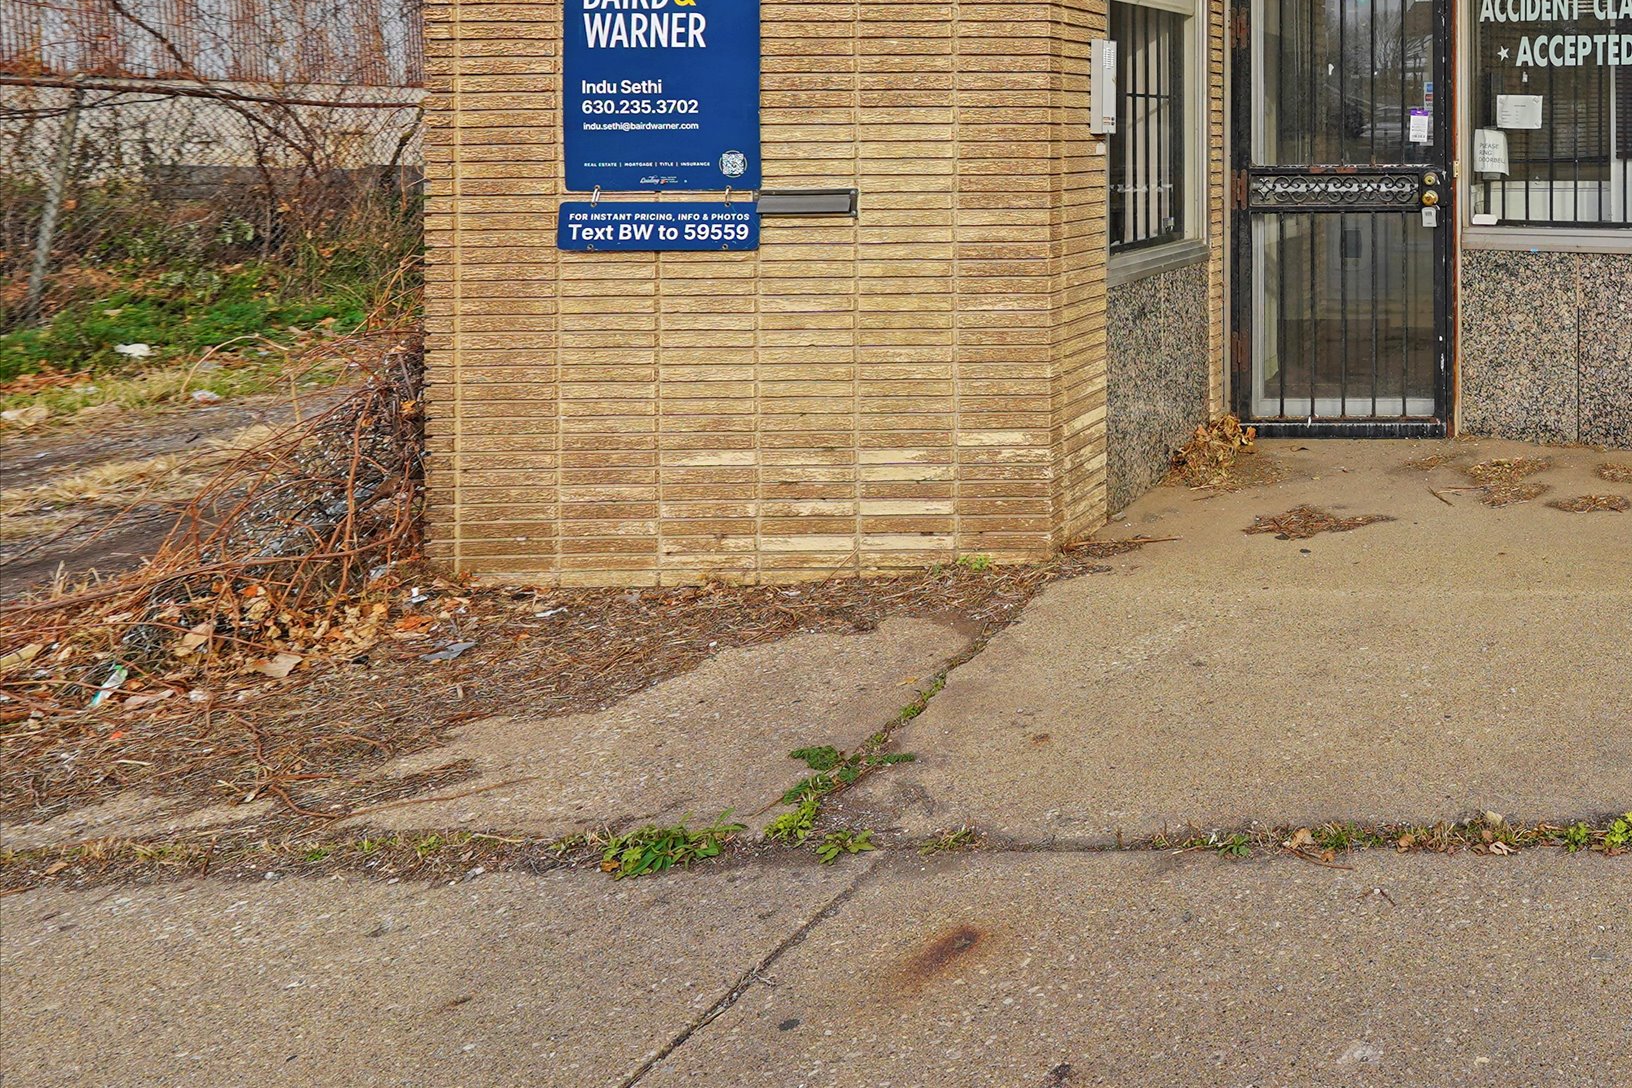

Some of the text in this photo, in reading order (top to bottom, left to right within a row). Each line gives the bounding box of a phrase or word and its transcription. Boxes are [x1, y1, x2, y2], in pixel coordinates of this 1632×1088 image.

[583, 12, 706, 48] WARNER
[581, 79, 662, 94] Indu Sethi
[581, 99, 699, 114] 630.235.3702
[583, 122, 699, 132] indu.sethi@bairdwarner.com
[634, 213, 675, 222] PRICING,
[568, 224, 749, 241] Text BW to 59559
